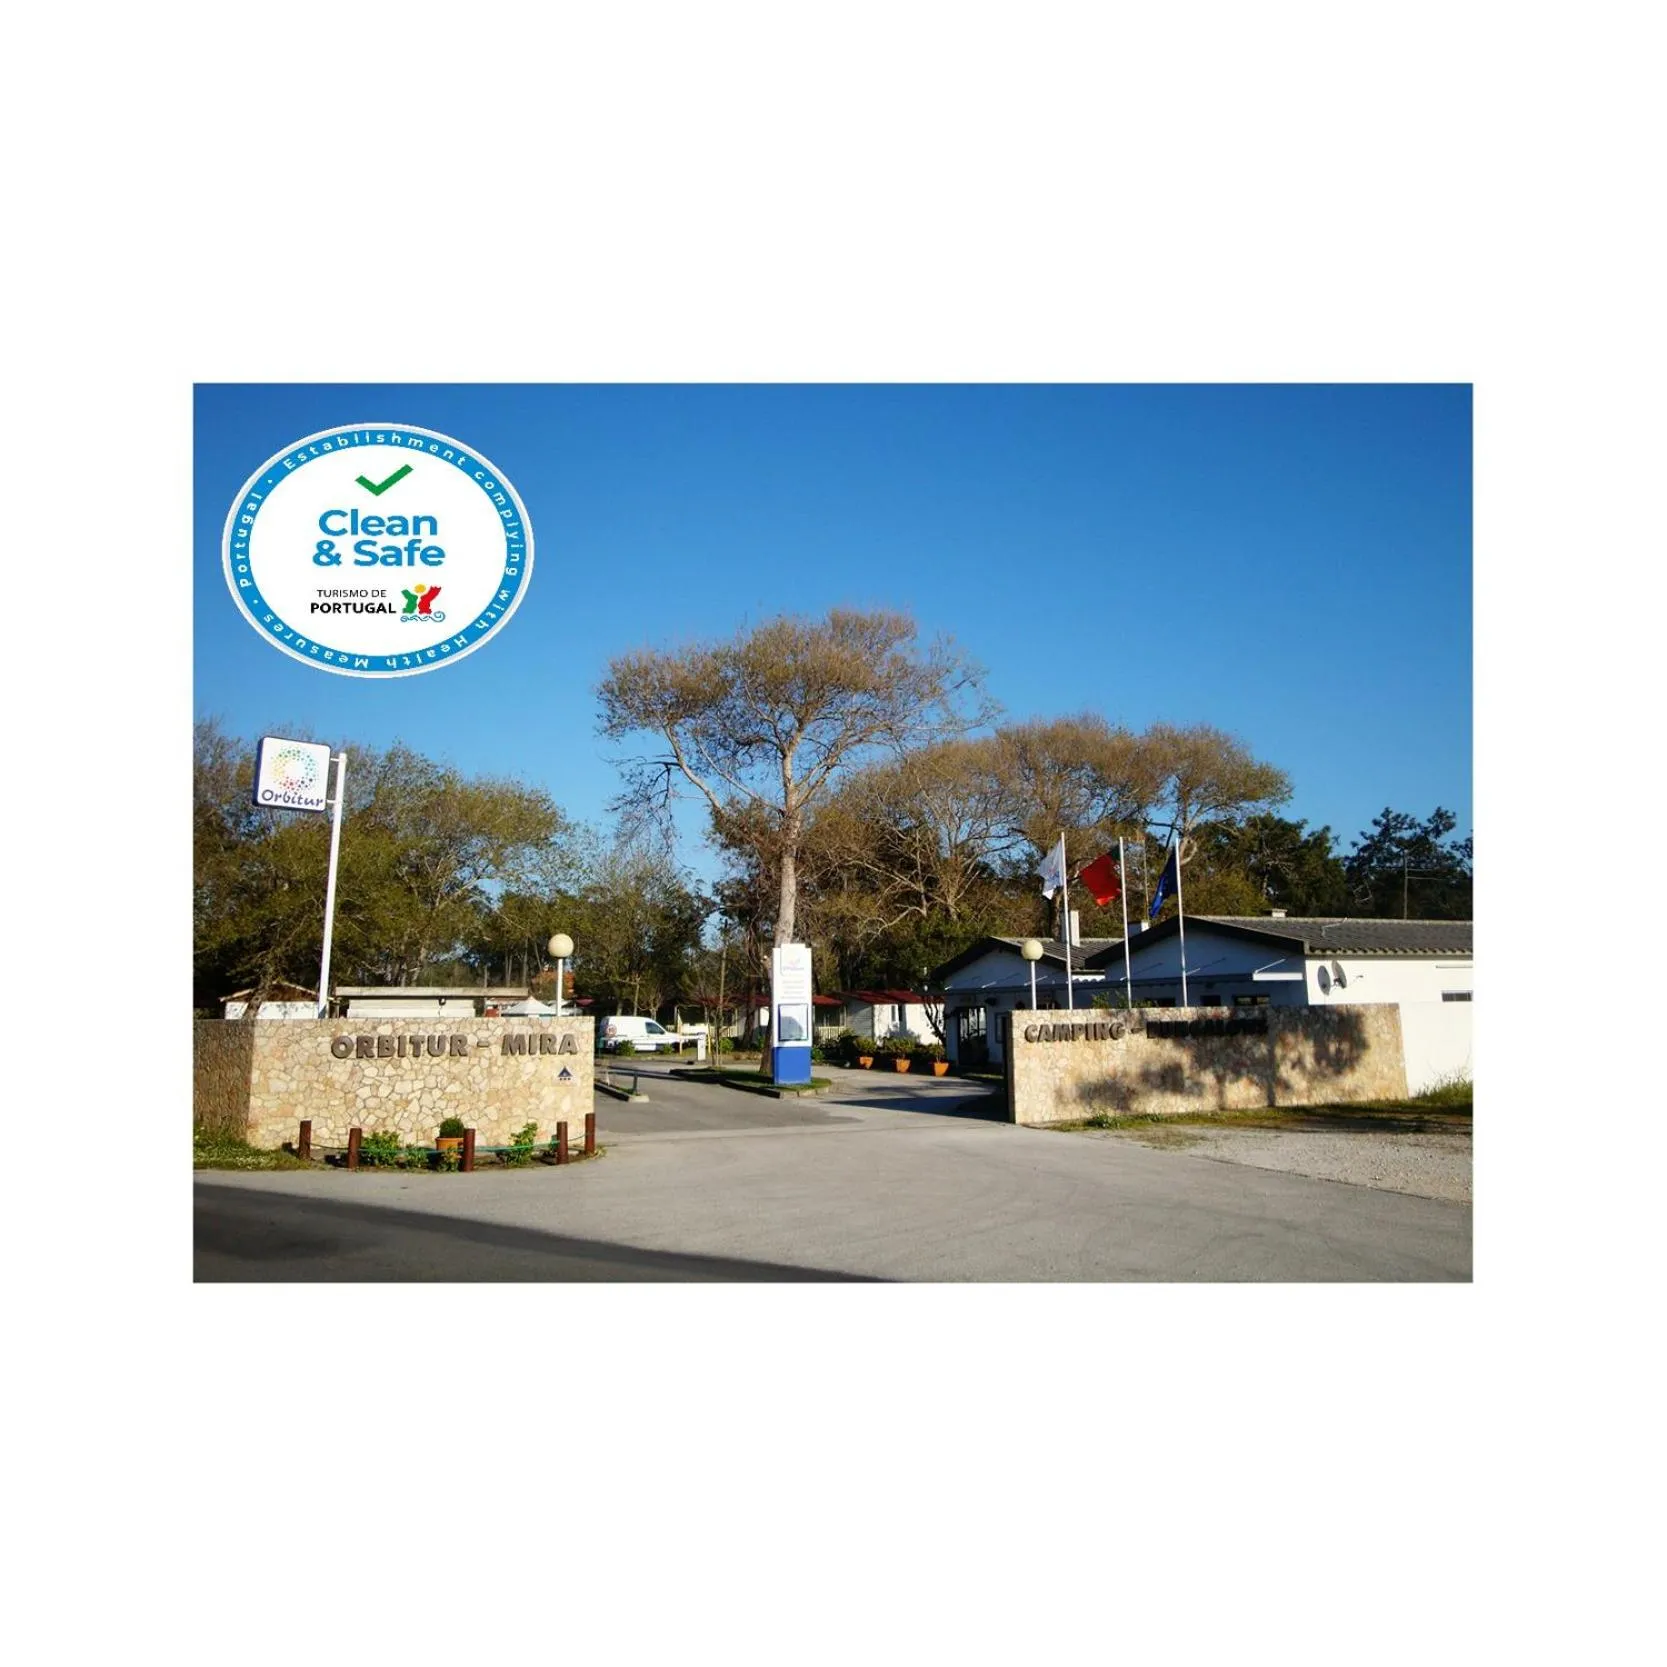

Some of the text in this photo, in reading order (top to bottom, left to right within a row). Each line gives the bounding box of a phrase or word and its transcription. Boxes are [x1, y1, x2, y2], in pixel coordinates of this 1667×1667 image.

[261, 789, 324, 807] Orbitur
[1024, 1021, 1126, 1043] CAMPING
[330, 1034, 469, 1059] ORBITUR
[500, 1033, 579, 1056] MIRA
